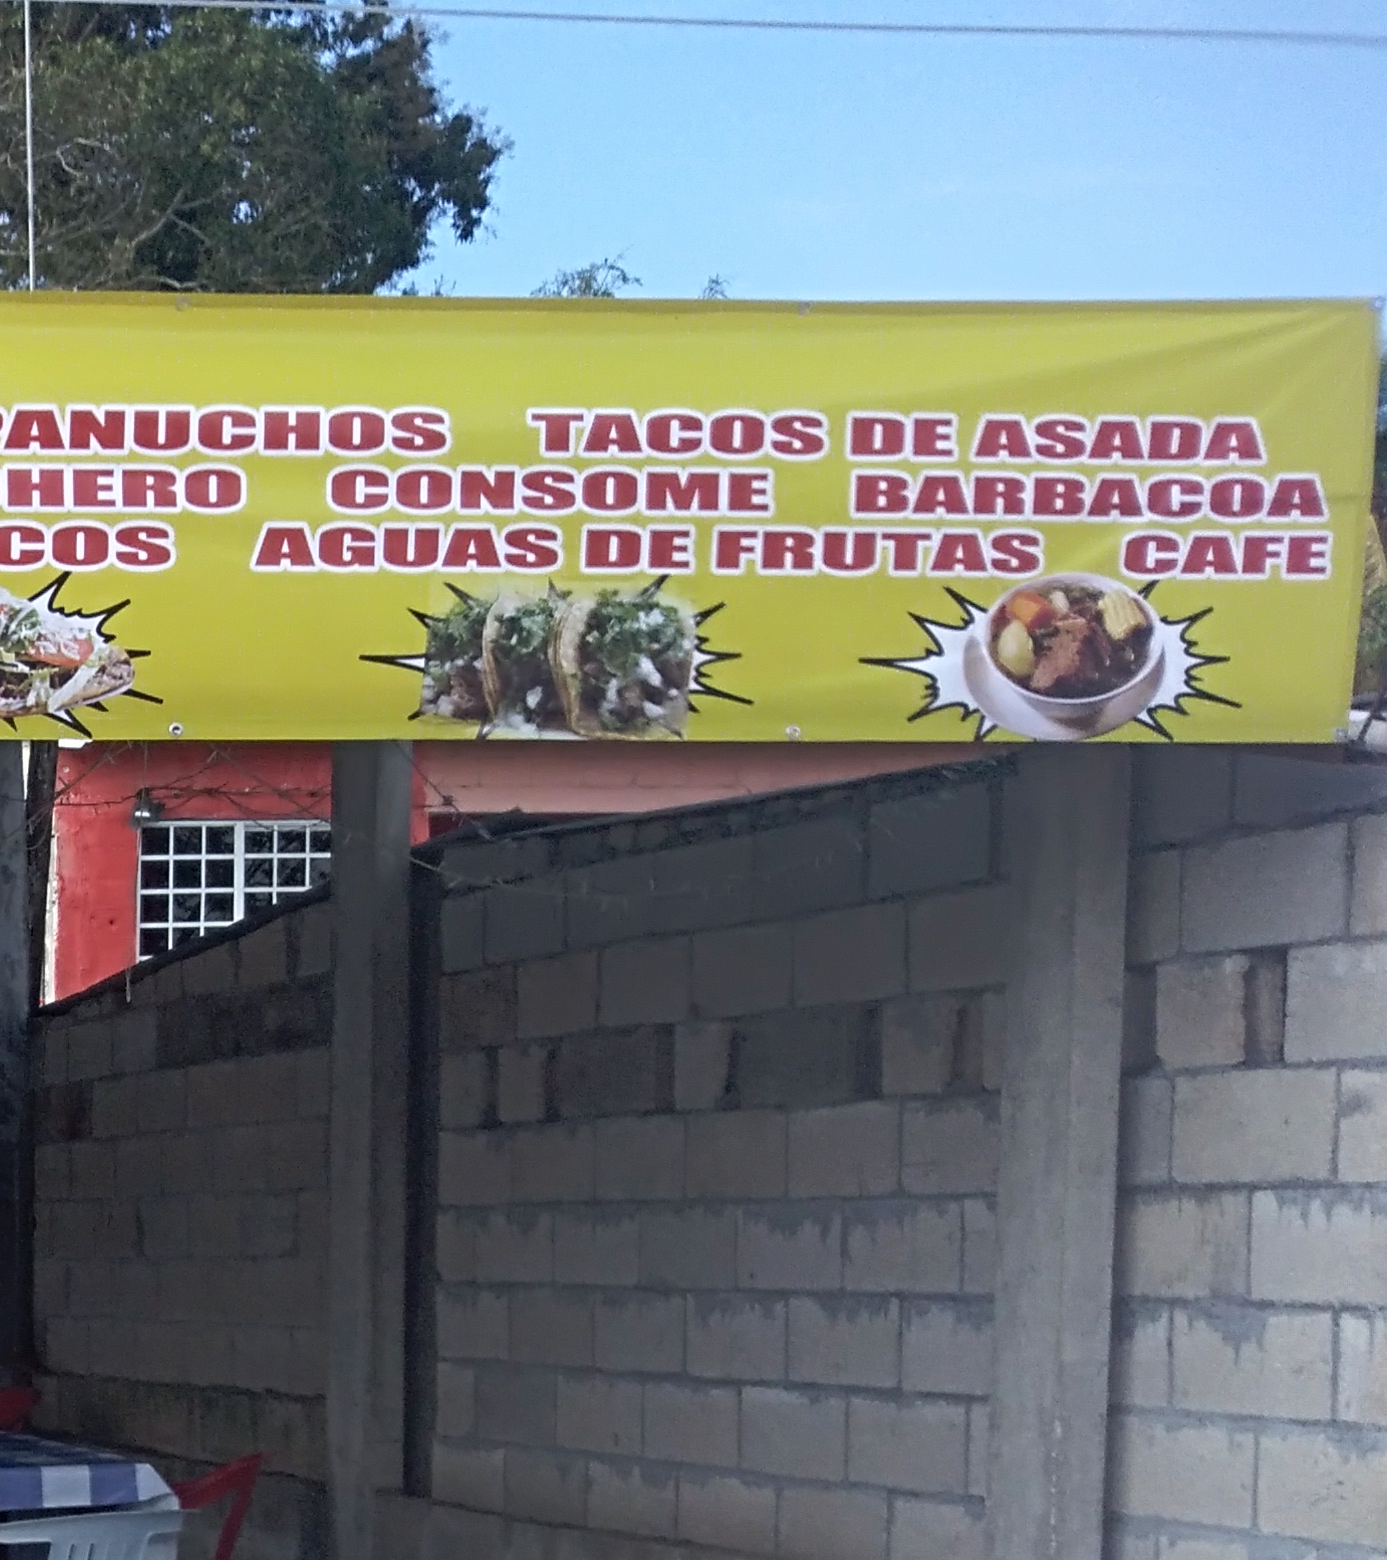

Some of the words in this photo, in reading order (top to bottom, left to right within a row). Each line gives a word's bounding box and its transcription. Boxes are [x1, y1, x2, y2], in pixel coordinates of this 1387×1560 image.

[531, 410, 827, 459] TACOS
[847, 413, 949, 460] DE
[972, 416, 1262, 464] ASADA
[327, 465, 769, 515] CONSOME
[851, 471, 1323, 521] BARBACOA
[252, 523, 562, 573] AGUAS
[581, 525, 693, 573] DE
[712, 526, 1041, 577] FRUTAS
[1119, 528, 1332, 581] CAFE
